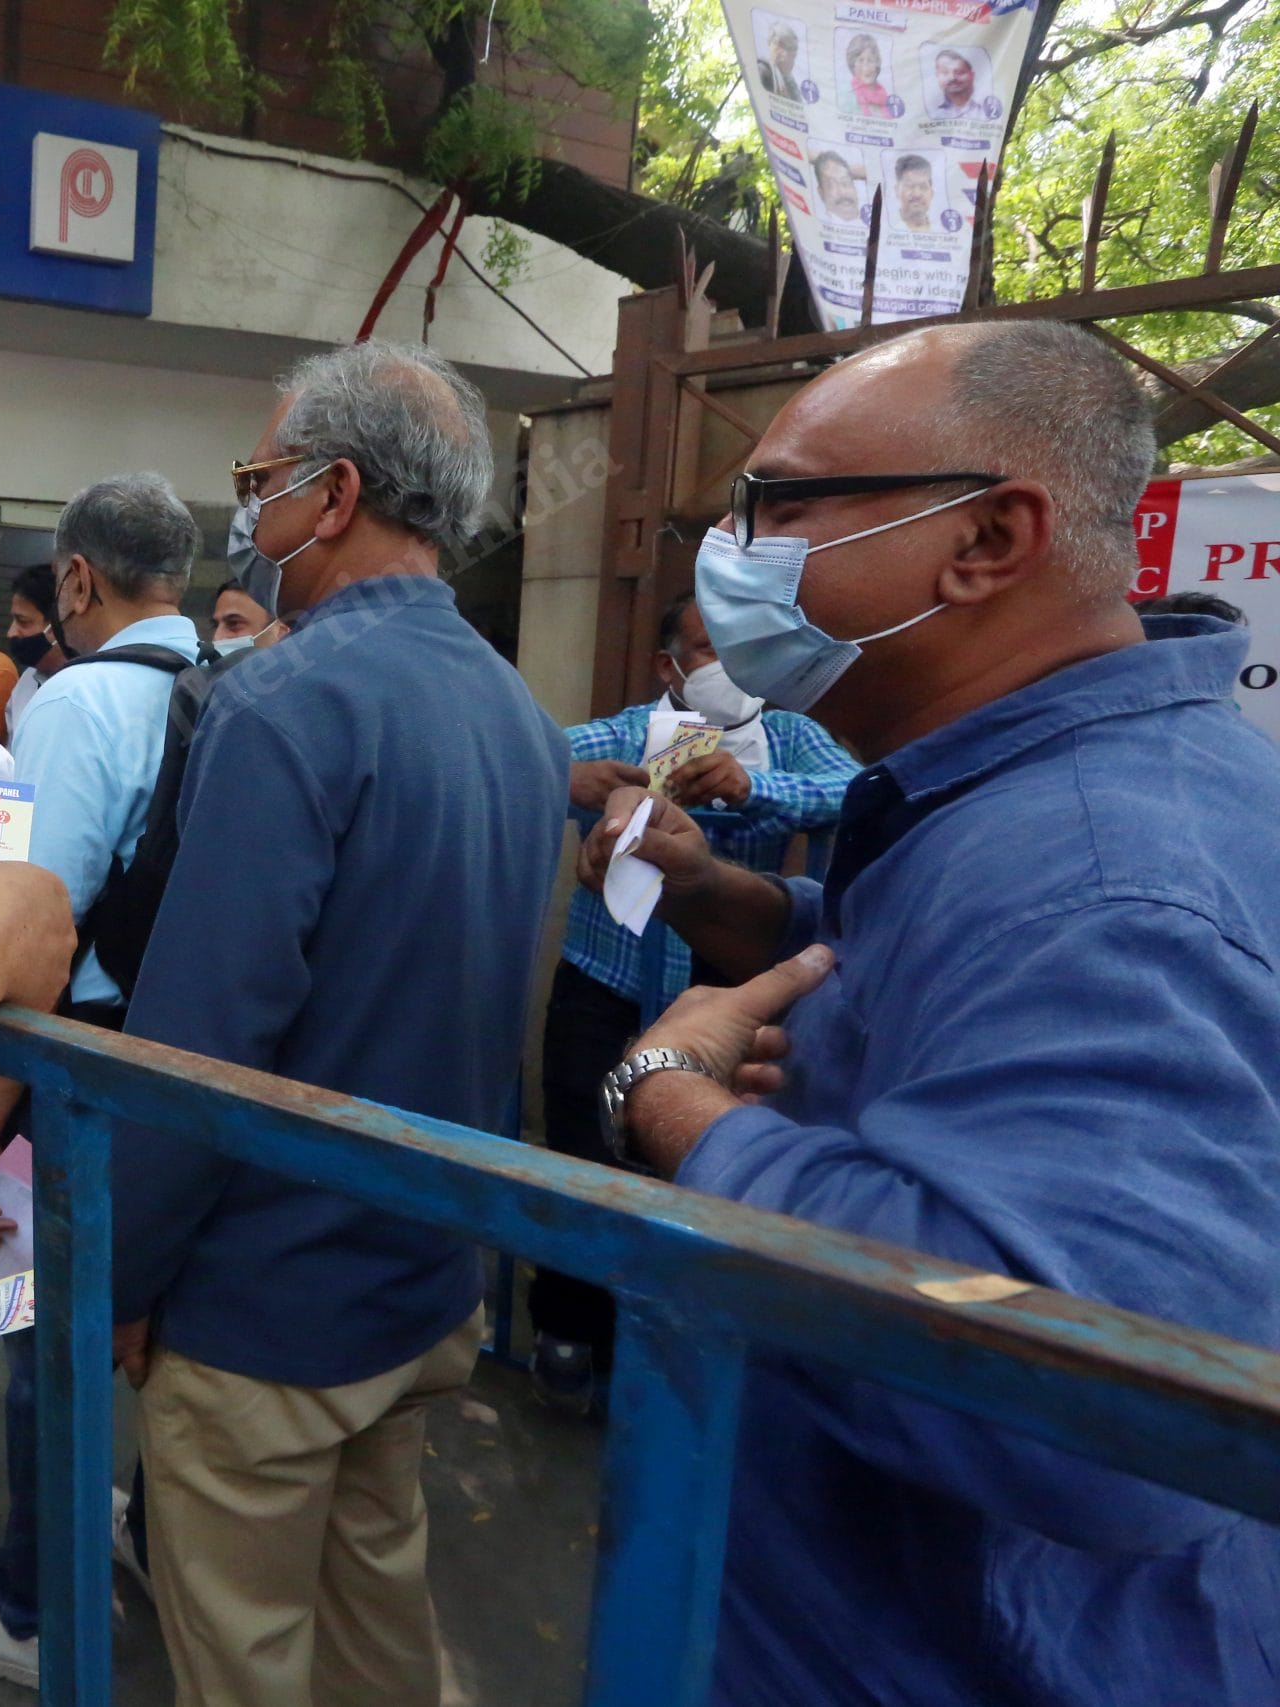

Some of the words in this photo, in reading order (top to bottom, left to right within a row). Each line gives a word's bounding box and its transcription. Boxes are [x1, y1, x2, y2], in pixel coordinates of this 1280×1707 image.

[849, 7, 892, 23] PANEL
[924, 269, 953, 282] with
[850, 278, 892, 294] faes,
[896, 284, 925, 296] new
[928, 285, 962, 299] ideas
[872, 299, 917, 313] ANAGING
